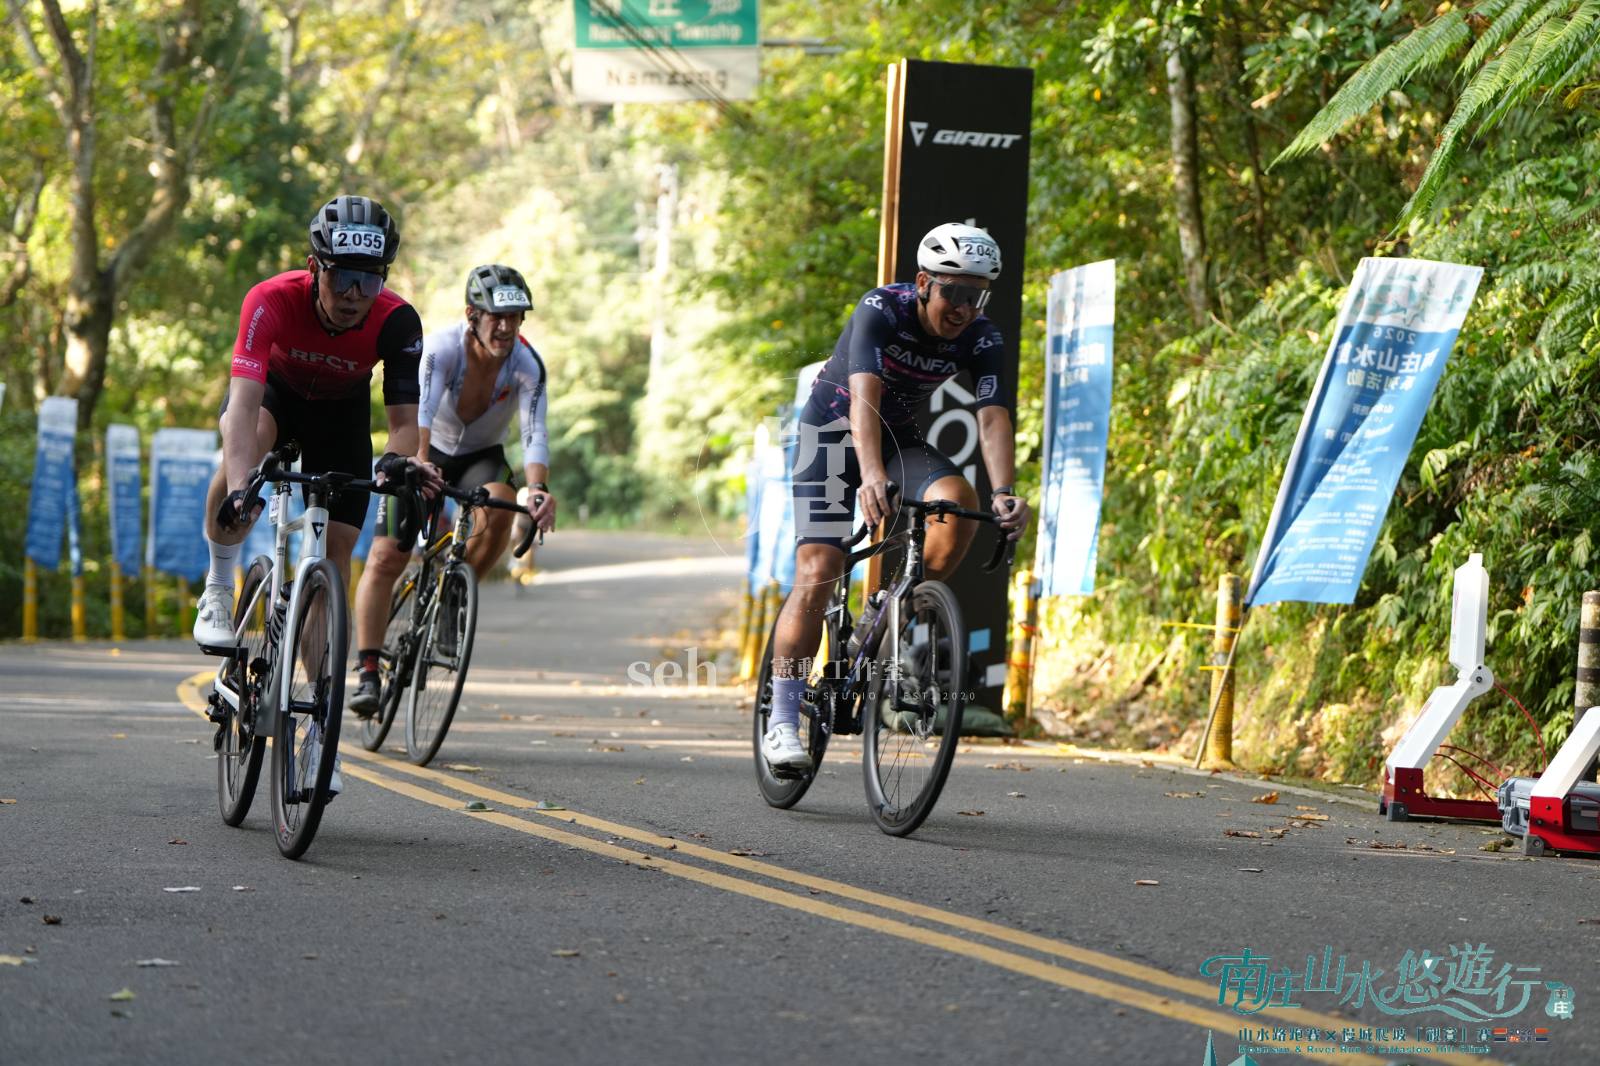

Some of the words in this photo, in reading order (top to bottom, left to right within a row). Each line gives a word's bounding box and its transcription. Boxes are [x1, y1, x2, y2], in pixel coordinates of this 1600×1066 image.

[932, 129, 1022, 149] GIANT
[338, 232, 382, 250] 2055
[233, 357, 259, 369] RFCT
[288, 347, 359, 371] RFCT
[884, 344, 958, 373] SANFA
